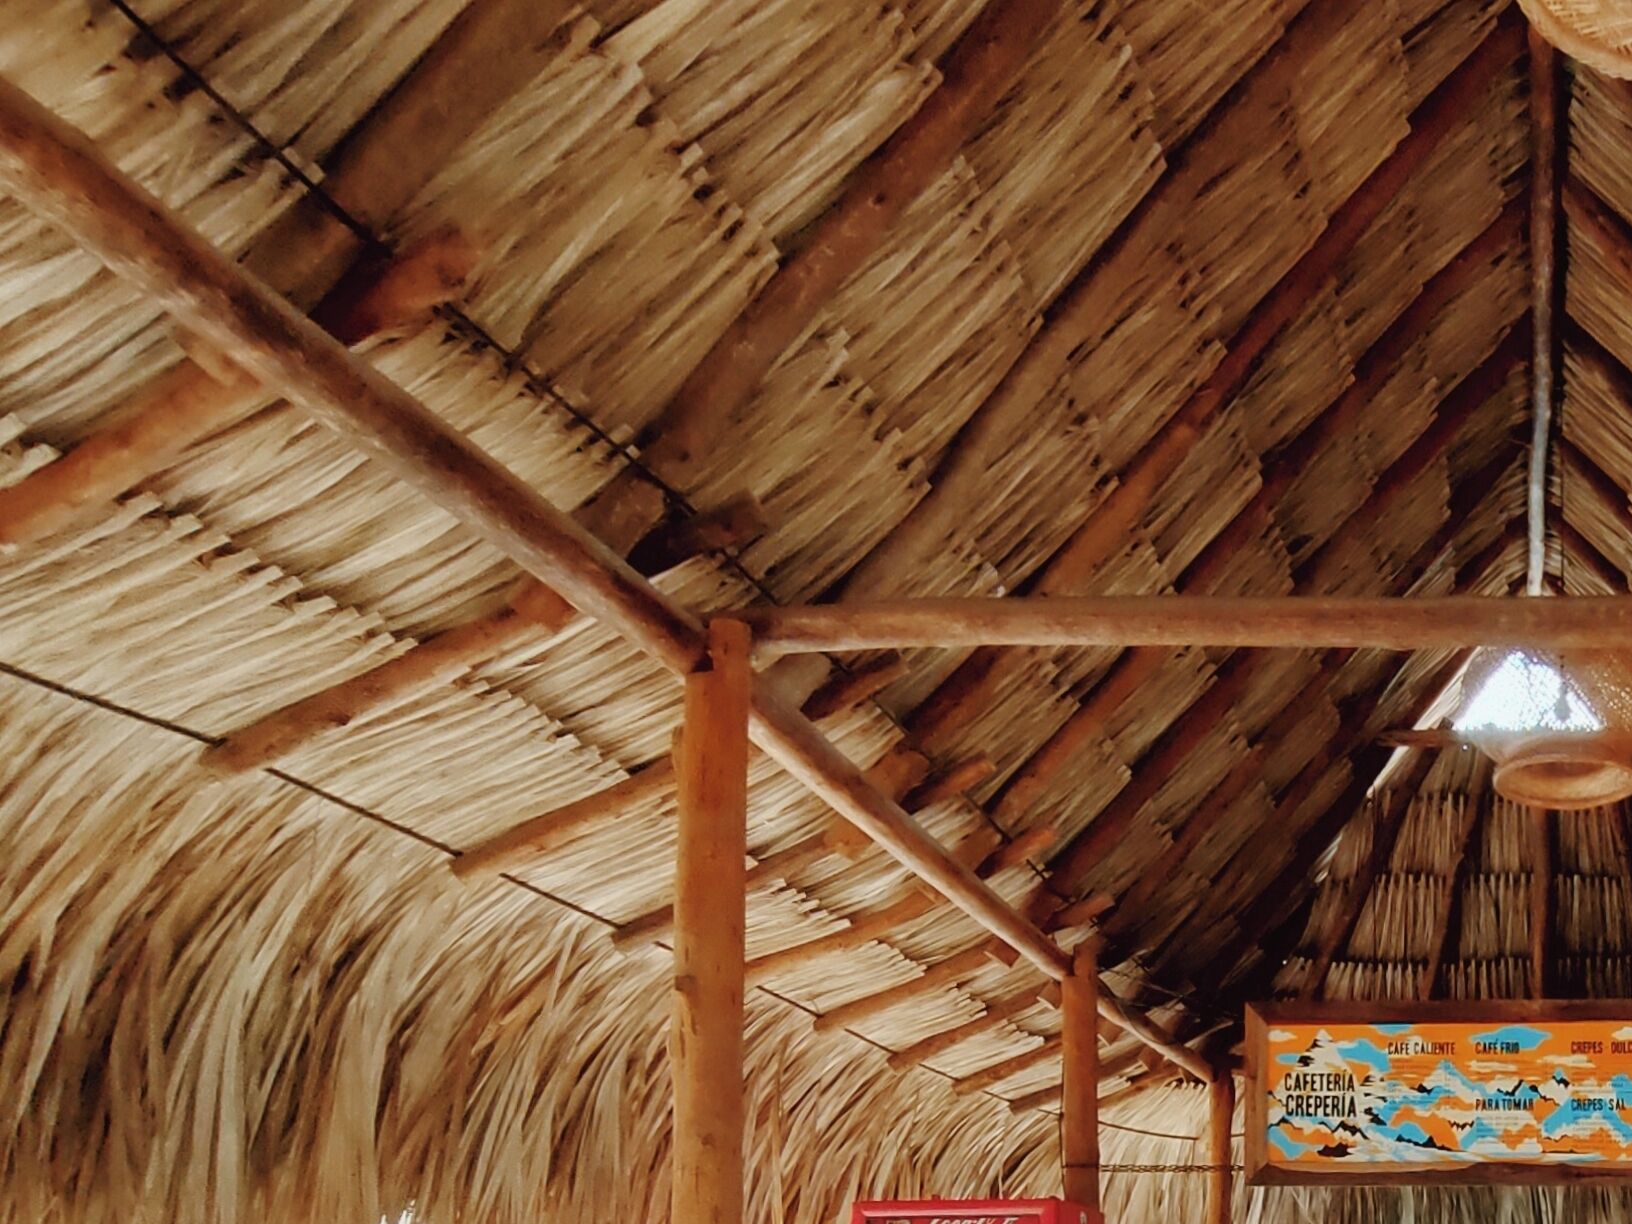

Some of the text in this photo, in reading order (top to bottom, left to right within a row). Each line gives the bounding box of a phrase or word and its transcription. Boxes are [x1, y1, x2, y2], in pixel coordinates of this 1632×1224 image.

[1413, 1041, 1456, 1056] CALIENTE
[1570, 1040, 1603, 1055] CREPES
[1284, 1069, 1356, 1092] CAFETERÍA
[1285, 1093, 1357, 1118] CREPERÍA
[1475, 1098, 1534, 1112] PARA TOMAR
[1570, 1097, 1627, 1112] CREPES SAL
